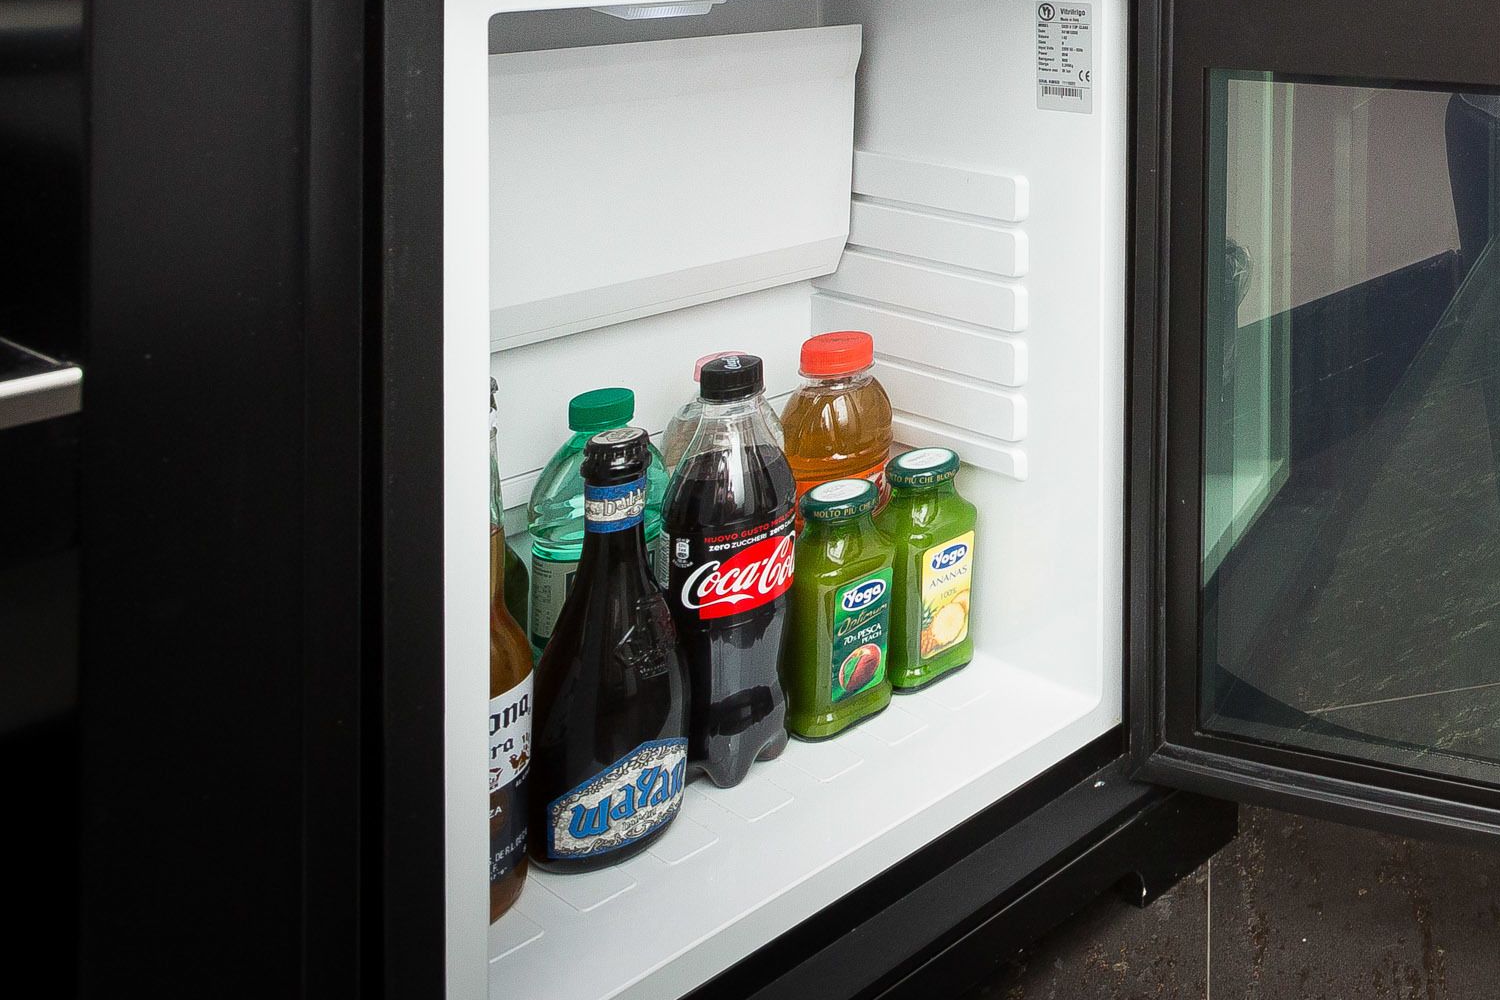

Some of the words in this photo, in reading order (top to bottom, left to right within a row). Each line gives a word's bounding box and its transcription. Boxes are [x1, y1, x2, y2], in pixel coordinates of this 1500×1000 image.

[1060, 8, 1086, 17] Vitrifrigo
[919, 476, 934, 484] CHE
[813, 510, 841, 519] MOLTO
[704, 532, 739, 544] NUOVO
[740, 522, 770, 538] GUSTO
[708, 543, 731, 552] zero
[731, 532, 768, 549] ZUCCHERI
[769, 523, 785, 536] zero
[933, 546, 966, 569] Yoga
[928, 564, 968, 591] ANANAS
[846, 584, 882, 608] Yoga
[837, 603, 888, 637] Optimum
[857, 622, 882, 640] PESCA
[861, 629, 882, 644] PEACH
